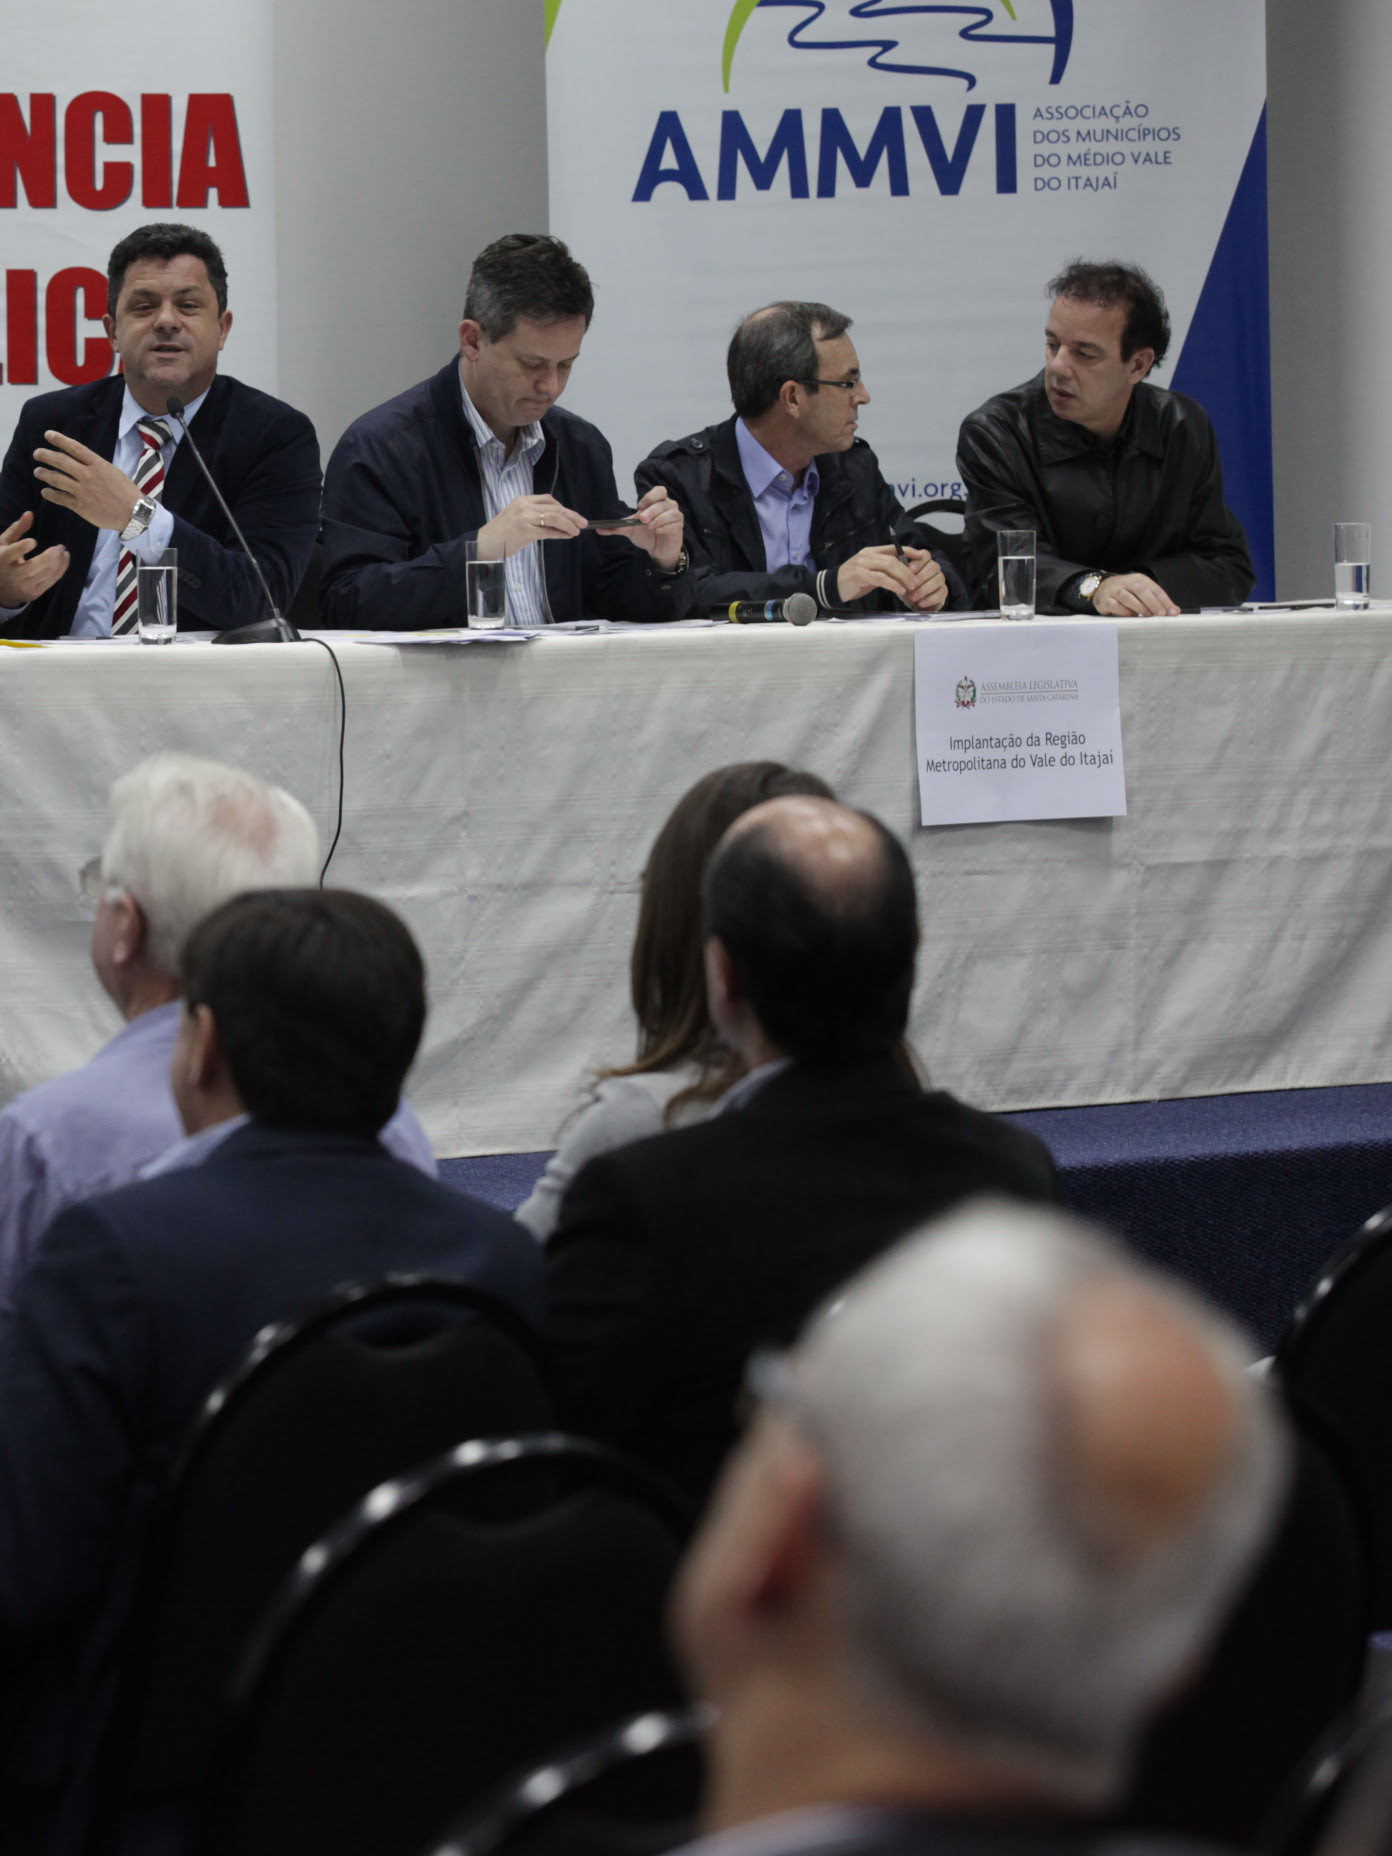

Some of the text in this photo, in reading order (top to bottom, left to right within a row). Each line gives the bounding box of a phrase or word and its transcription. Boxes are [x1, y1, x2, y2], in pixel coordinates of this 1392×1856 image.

[1033, 101, 1149, 123] ASSOCIAÇÃO
[1033, 124, 1181, 144] DOS MUNICÍPIOS
[631, 103, 1018, 202] AMMVI
[1033, 149, 1172, 168] DO MÉDIO VALE
[1034, 172, 1118, 192] DO ITAJAÍ
[981, 680, 1078, 691] ASSEMBLEIA LEGISLATIVA
[949, 731, 1086, 751] Implantação da Região
[926, 749, 1113, 774] Metropolitana do Vale do Itajaí
